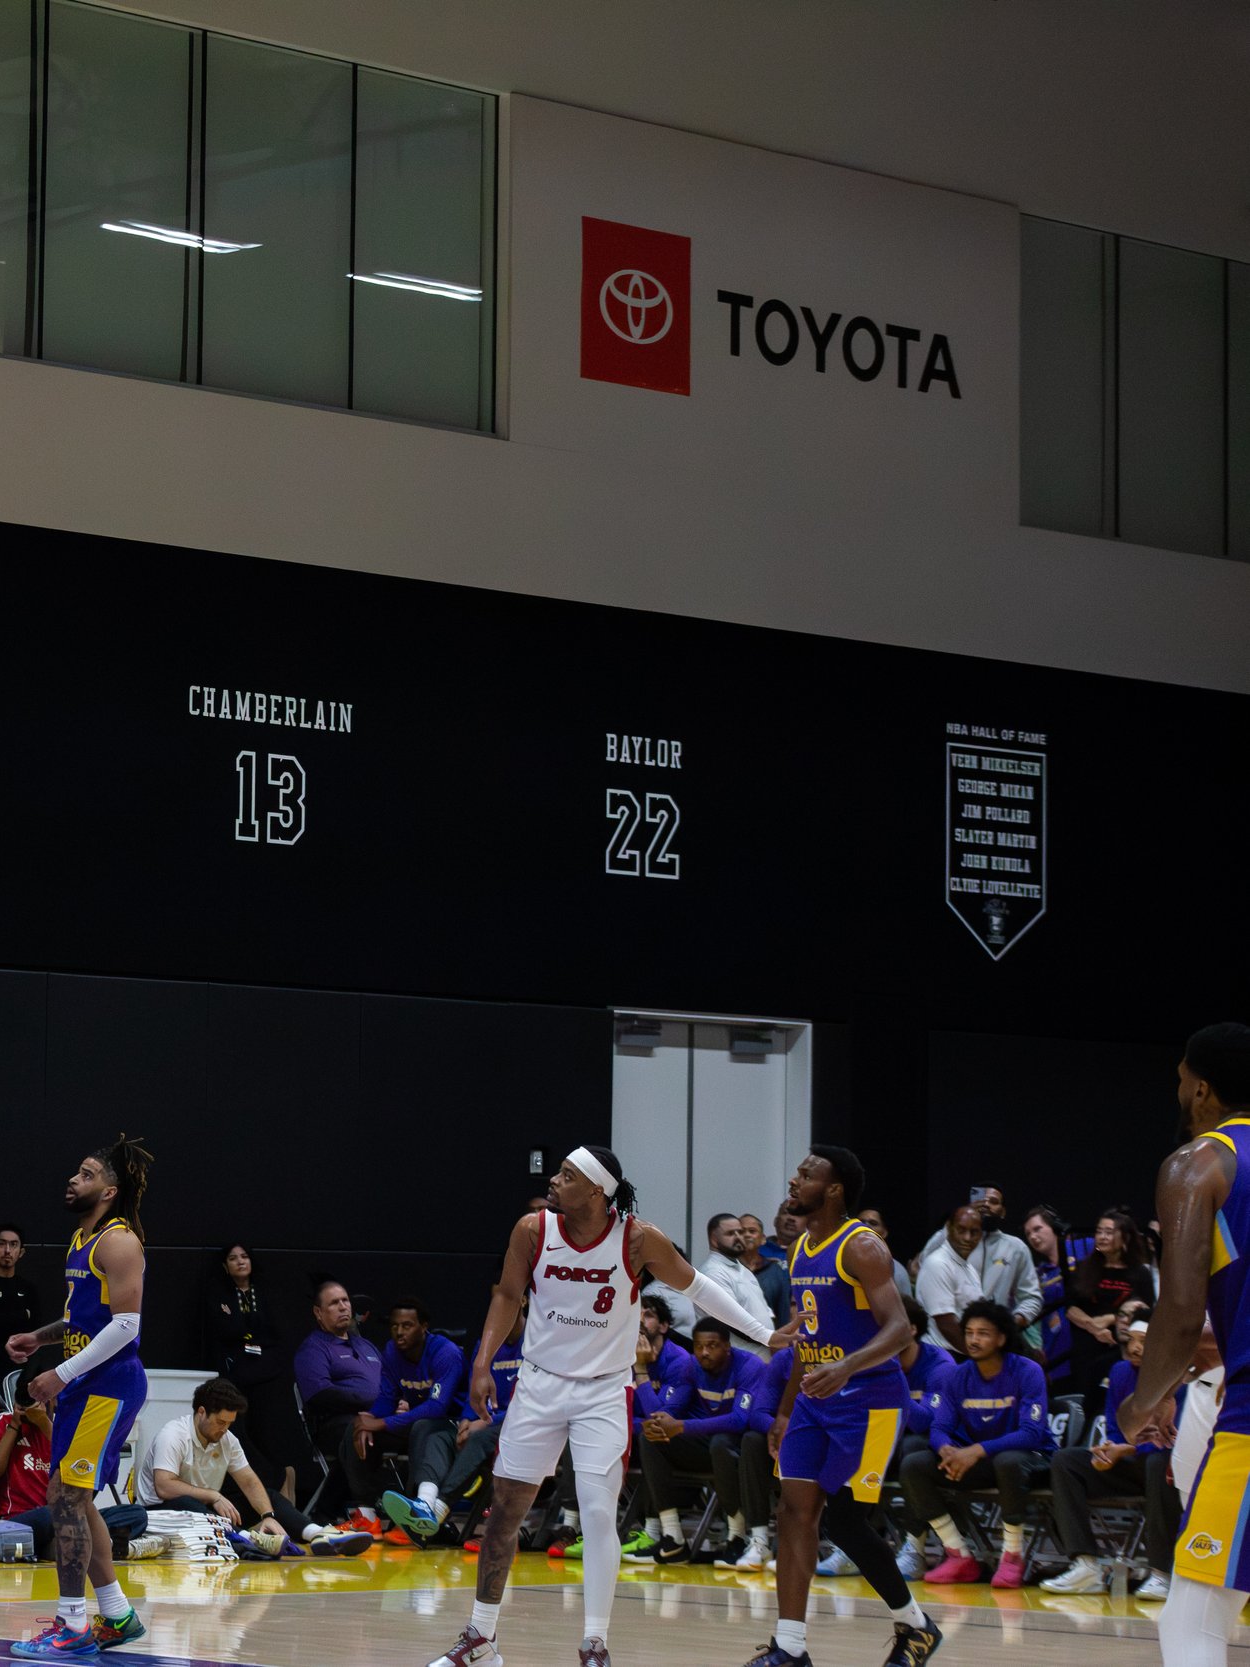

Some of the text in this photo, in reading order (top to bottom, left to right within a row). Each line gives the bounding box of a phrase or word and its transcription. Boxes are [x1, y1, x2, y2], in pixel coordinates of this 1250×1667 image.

[717, 289, 962, 399] TOYOTA
[188, 685, 353, 733] CHAMBERLAIN
[946, 722, 1048, 746] NBA HALL OF FAME
[605, 732, 683, 770] BAYLOR
[235, 750, 306, 846] 13
[957, 778, 1035, 801] GEORGE MIKAN
[961, 803, 983, 820] JIM
[605, 787, 681, 880] 22
[954, 827, 1038, 850] SLATER MARTIN
[960, 853, 989, 870] JOHN
[950, 876, 981, 894] CLYDE
[544, 1264, 617, 1284] FORCE
[593, 1286, 616, 1314] 8
[801, 1289, 819, 1335] 9
[556, 1314, 609, 1329] Robinhood
